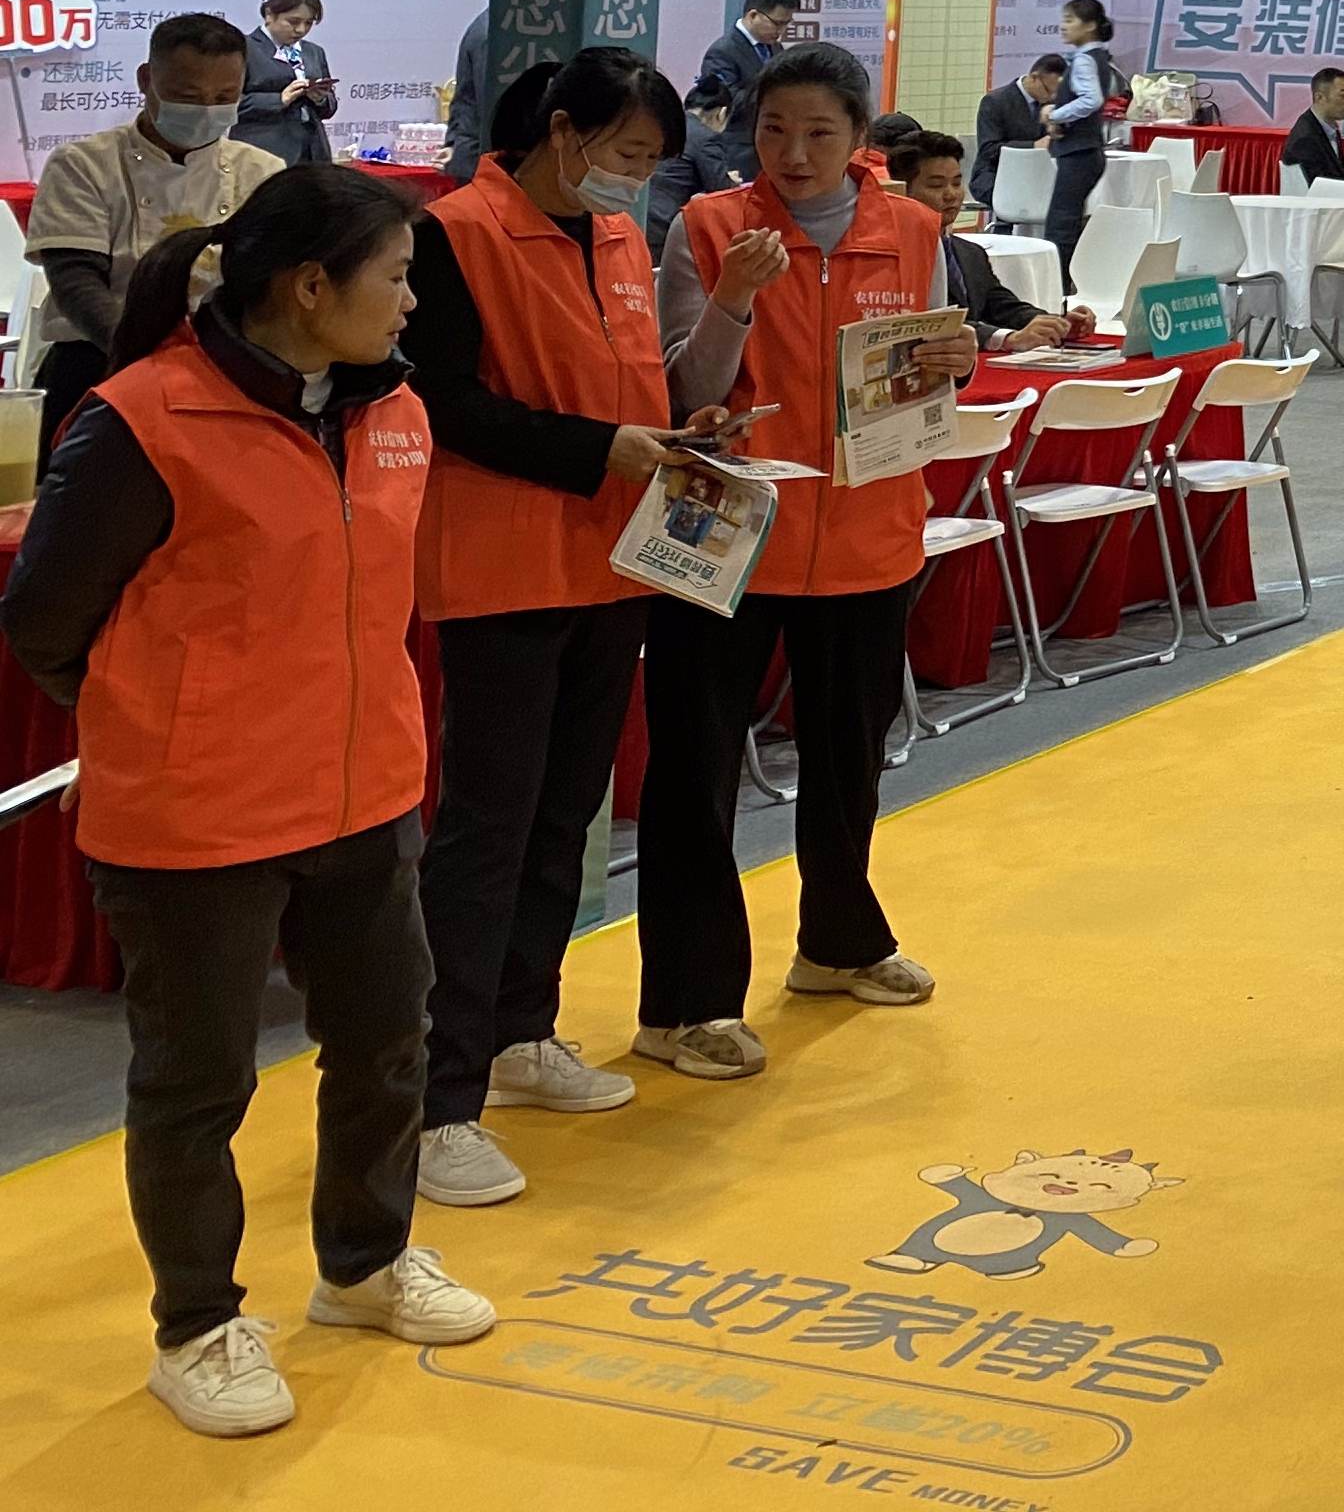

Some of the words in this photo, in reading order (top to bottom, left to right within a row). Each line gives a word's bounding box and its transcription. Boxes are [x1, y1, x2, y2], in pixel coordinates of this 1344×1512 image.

[42, 61, 124, 85] 还款期长
[853, 291, 915, 306] 农行信用卡
[522, 1248, 1226, 1403] 共好家博会
[727, 1445, 919, 1495] SAVE
